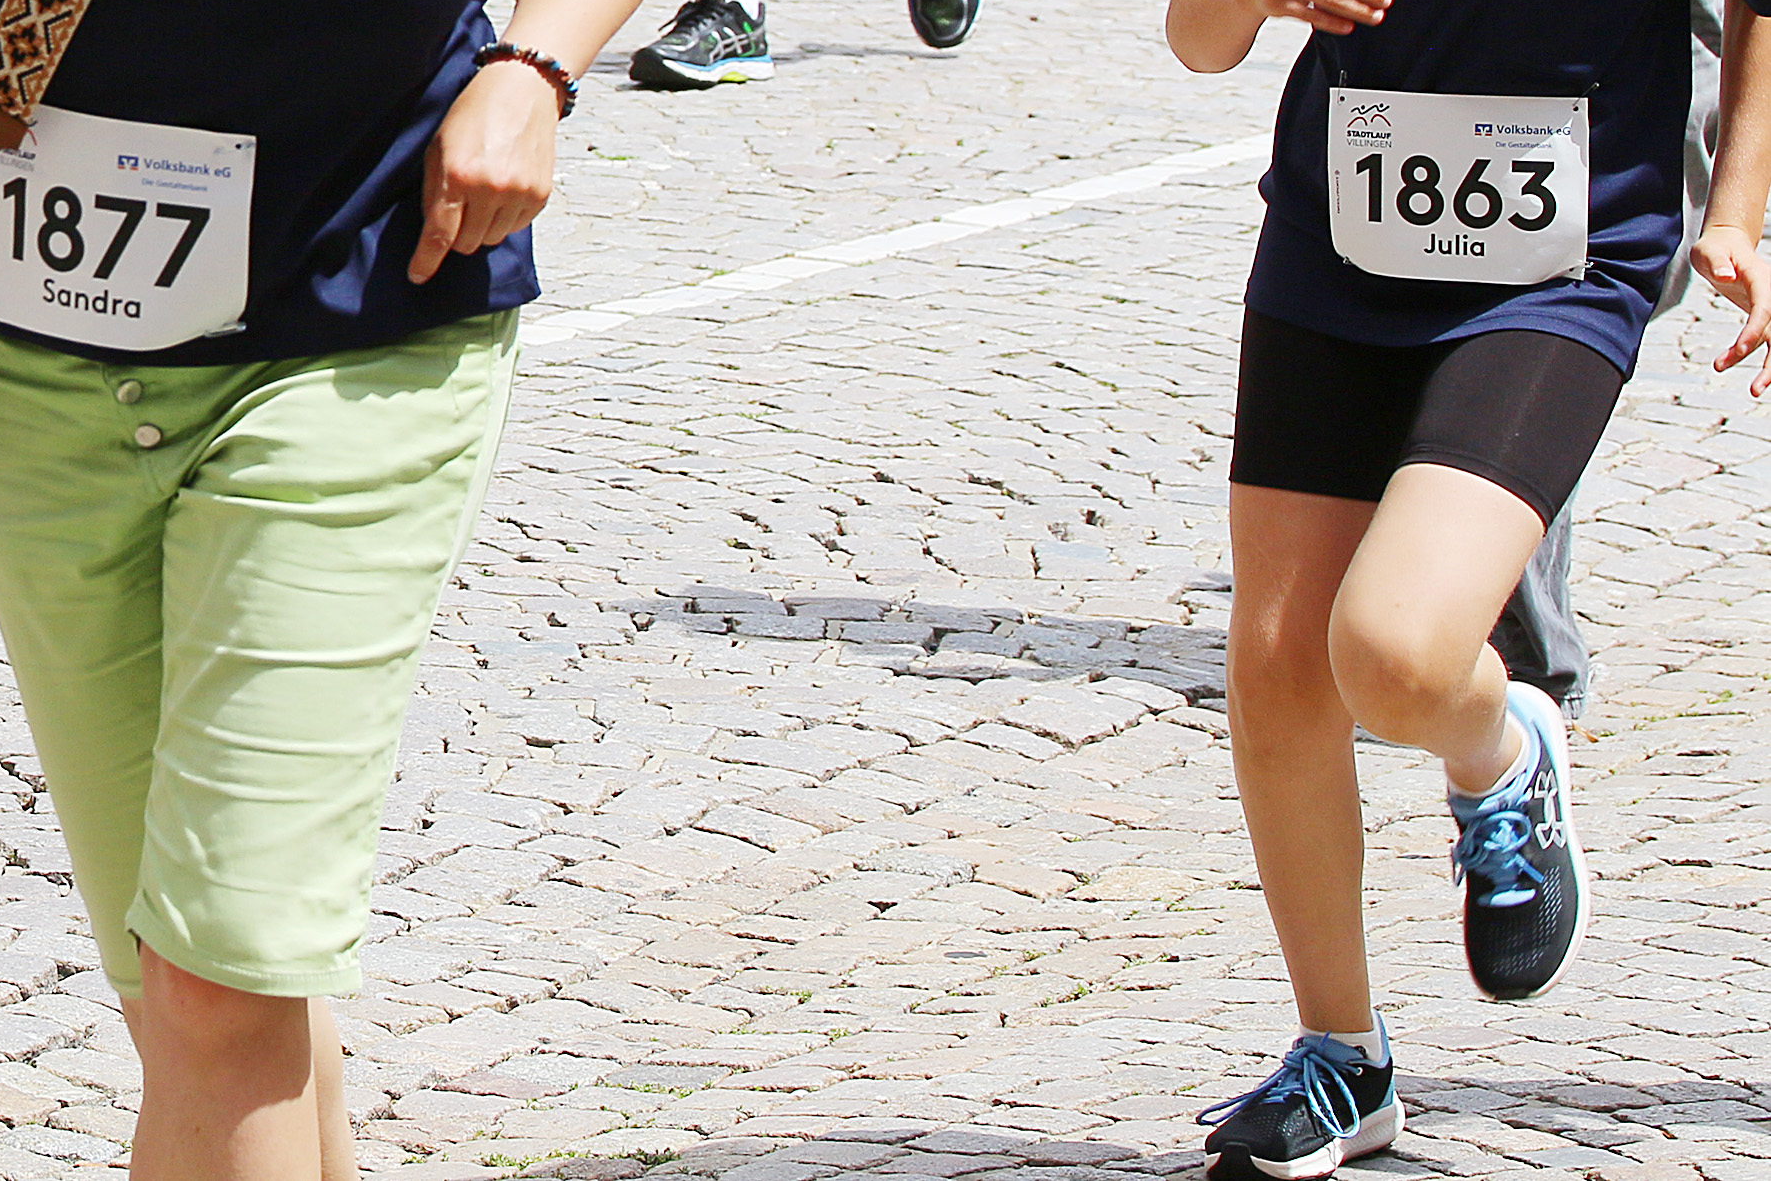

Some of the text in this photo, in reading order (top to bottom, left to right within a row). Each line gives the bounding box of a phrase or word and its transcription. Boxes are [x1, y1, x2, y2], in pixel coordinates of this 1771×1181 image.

[1346, 130, 1392, 139] STADTLAUF
[1496, 124, 1571, 136] Volksbank eG
[1346, 138, 1393, 148] VILLINGEN
[144, 158, 232, 178] Volksbank eG
[1355, 153, 1557, 231] 1863
[3, 177, 211, 288] 1877
[1423, 233, 1485, 256] Julia
[42, 278, 142, 318] Sandra
